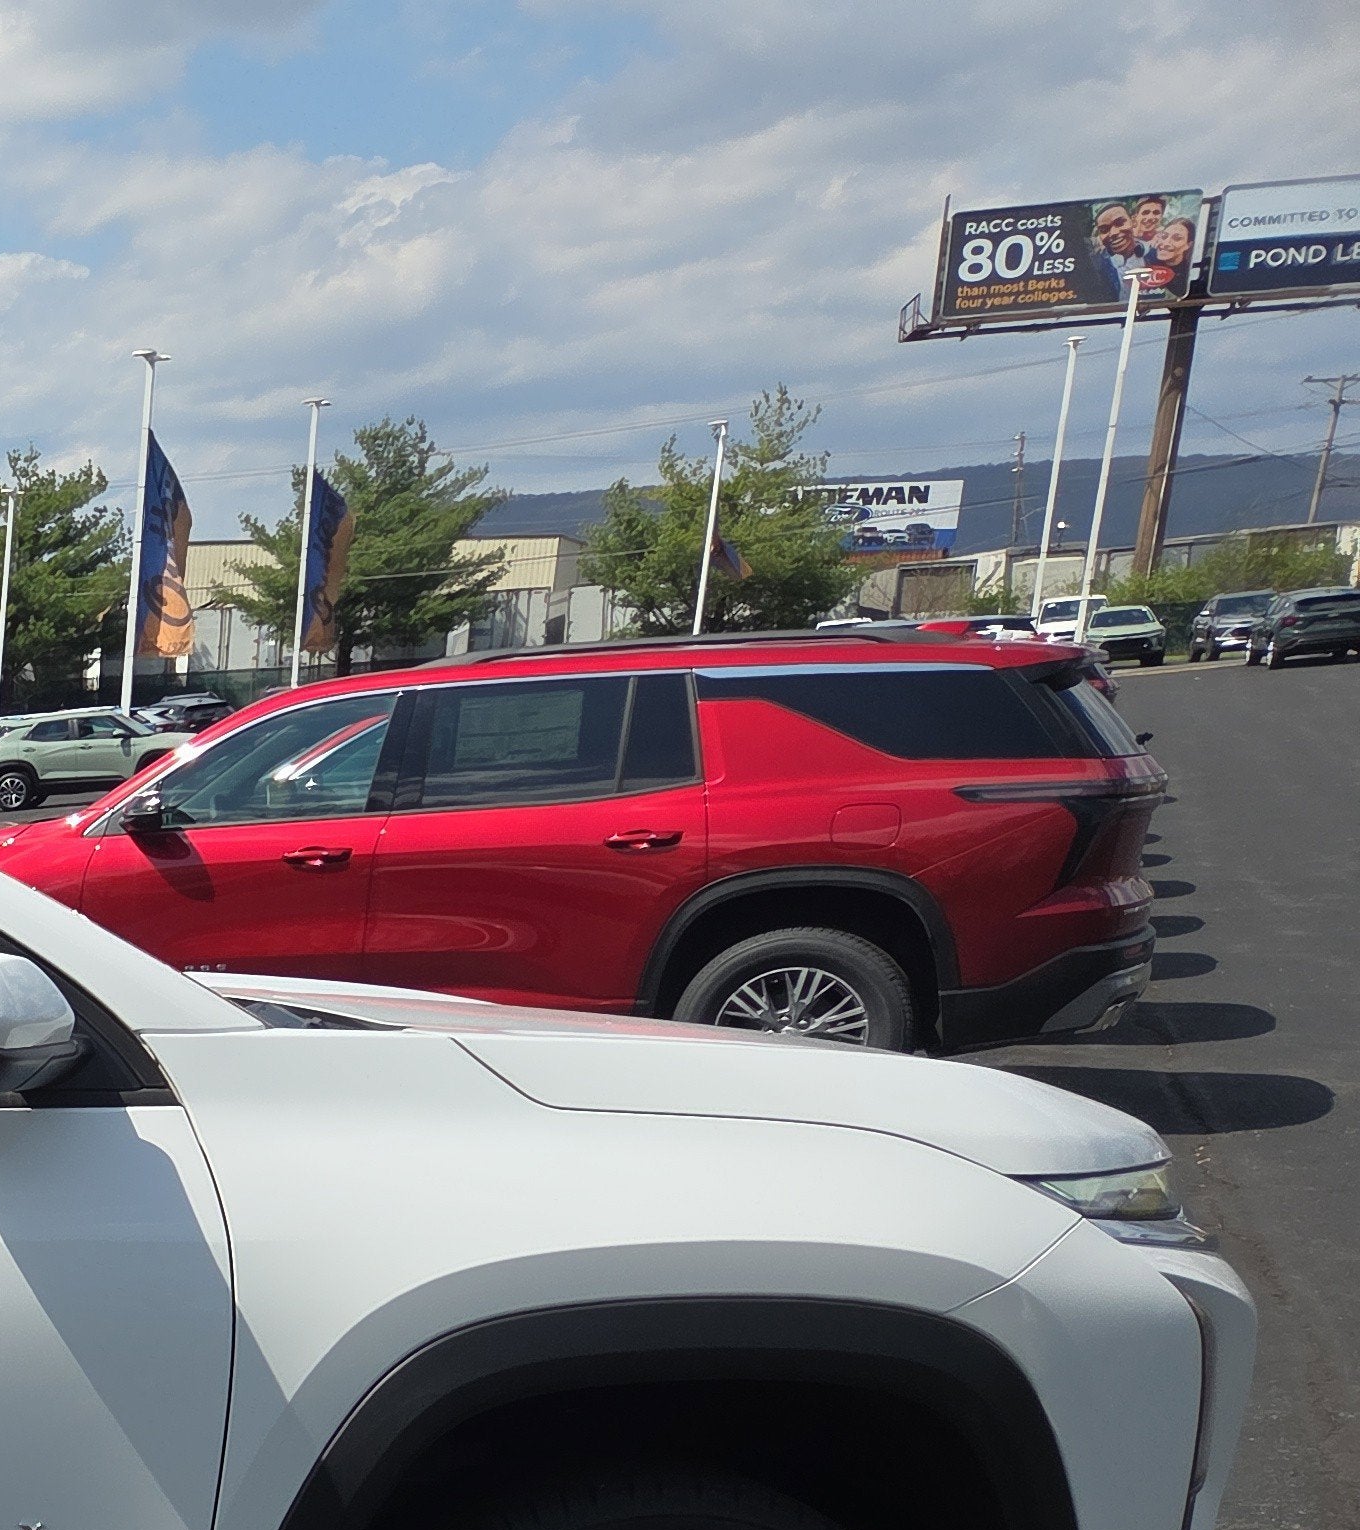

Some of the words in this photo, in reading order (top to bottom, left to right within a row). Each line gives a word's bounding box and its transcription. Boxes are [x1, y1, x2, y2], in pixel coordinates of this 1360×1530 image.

[964, 218, 1015, 235] RACC
[1017, 214, 1062, 230] costs
[1227, 210, 1330, 229] COMMITTED
[1336, 207, 1359, 220] TO
[1033, 257, 1076, 275] LESS
[1248, 244, 1327, 269] POND
[957, 285, 988, 297] than
[990, 281, 1025, 295] most
[1027, 278, 1065, 290] Berks
[955, 297, 982, 309] four
[984, 295, 1016, 309] year
[1017, 290, 1078, 303] colleges.
